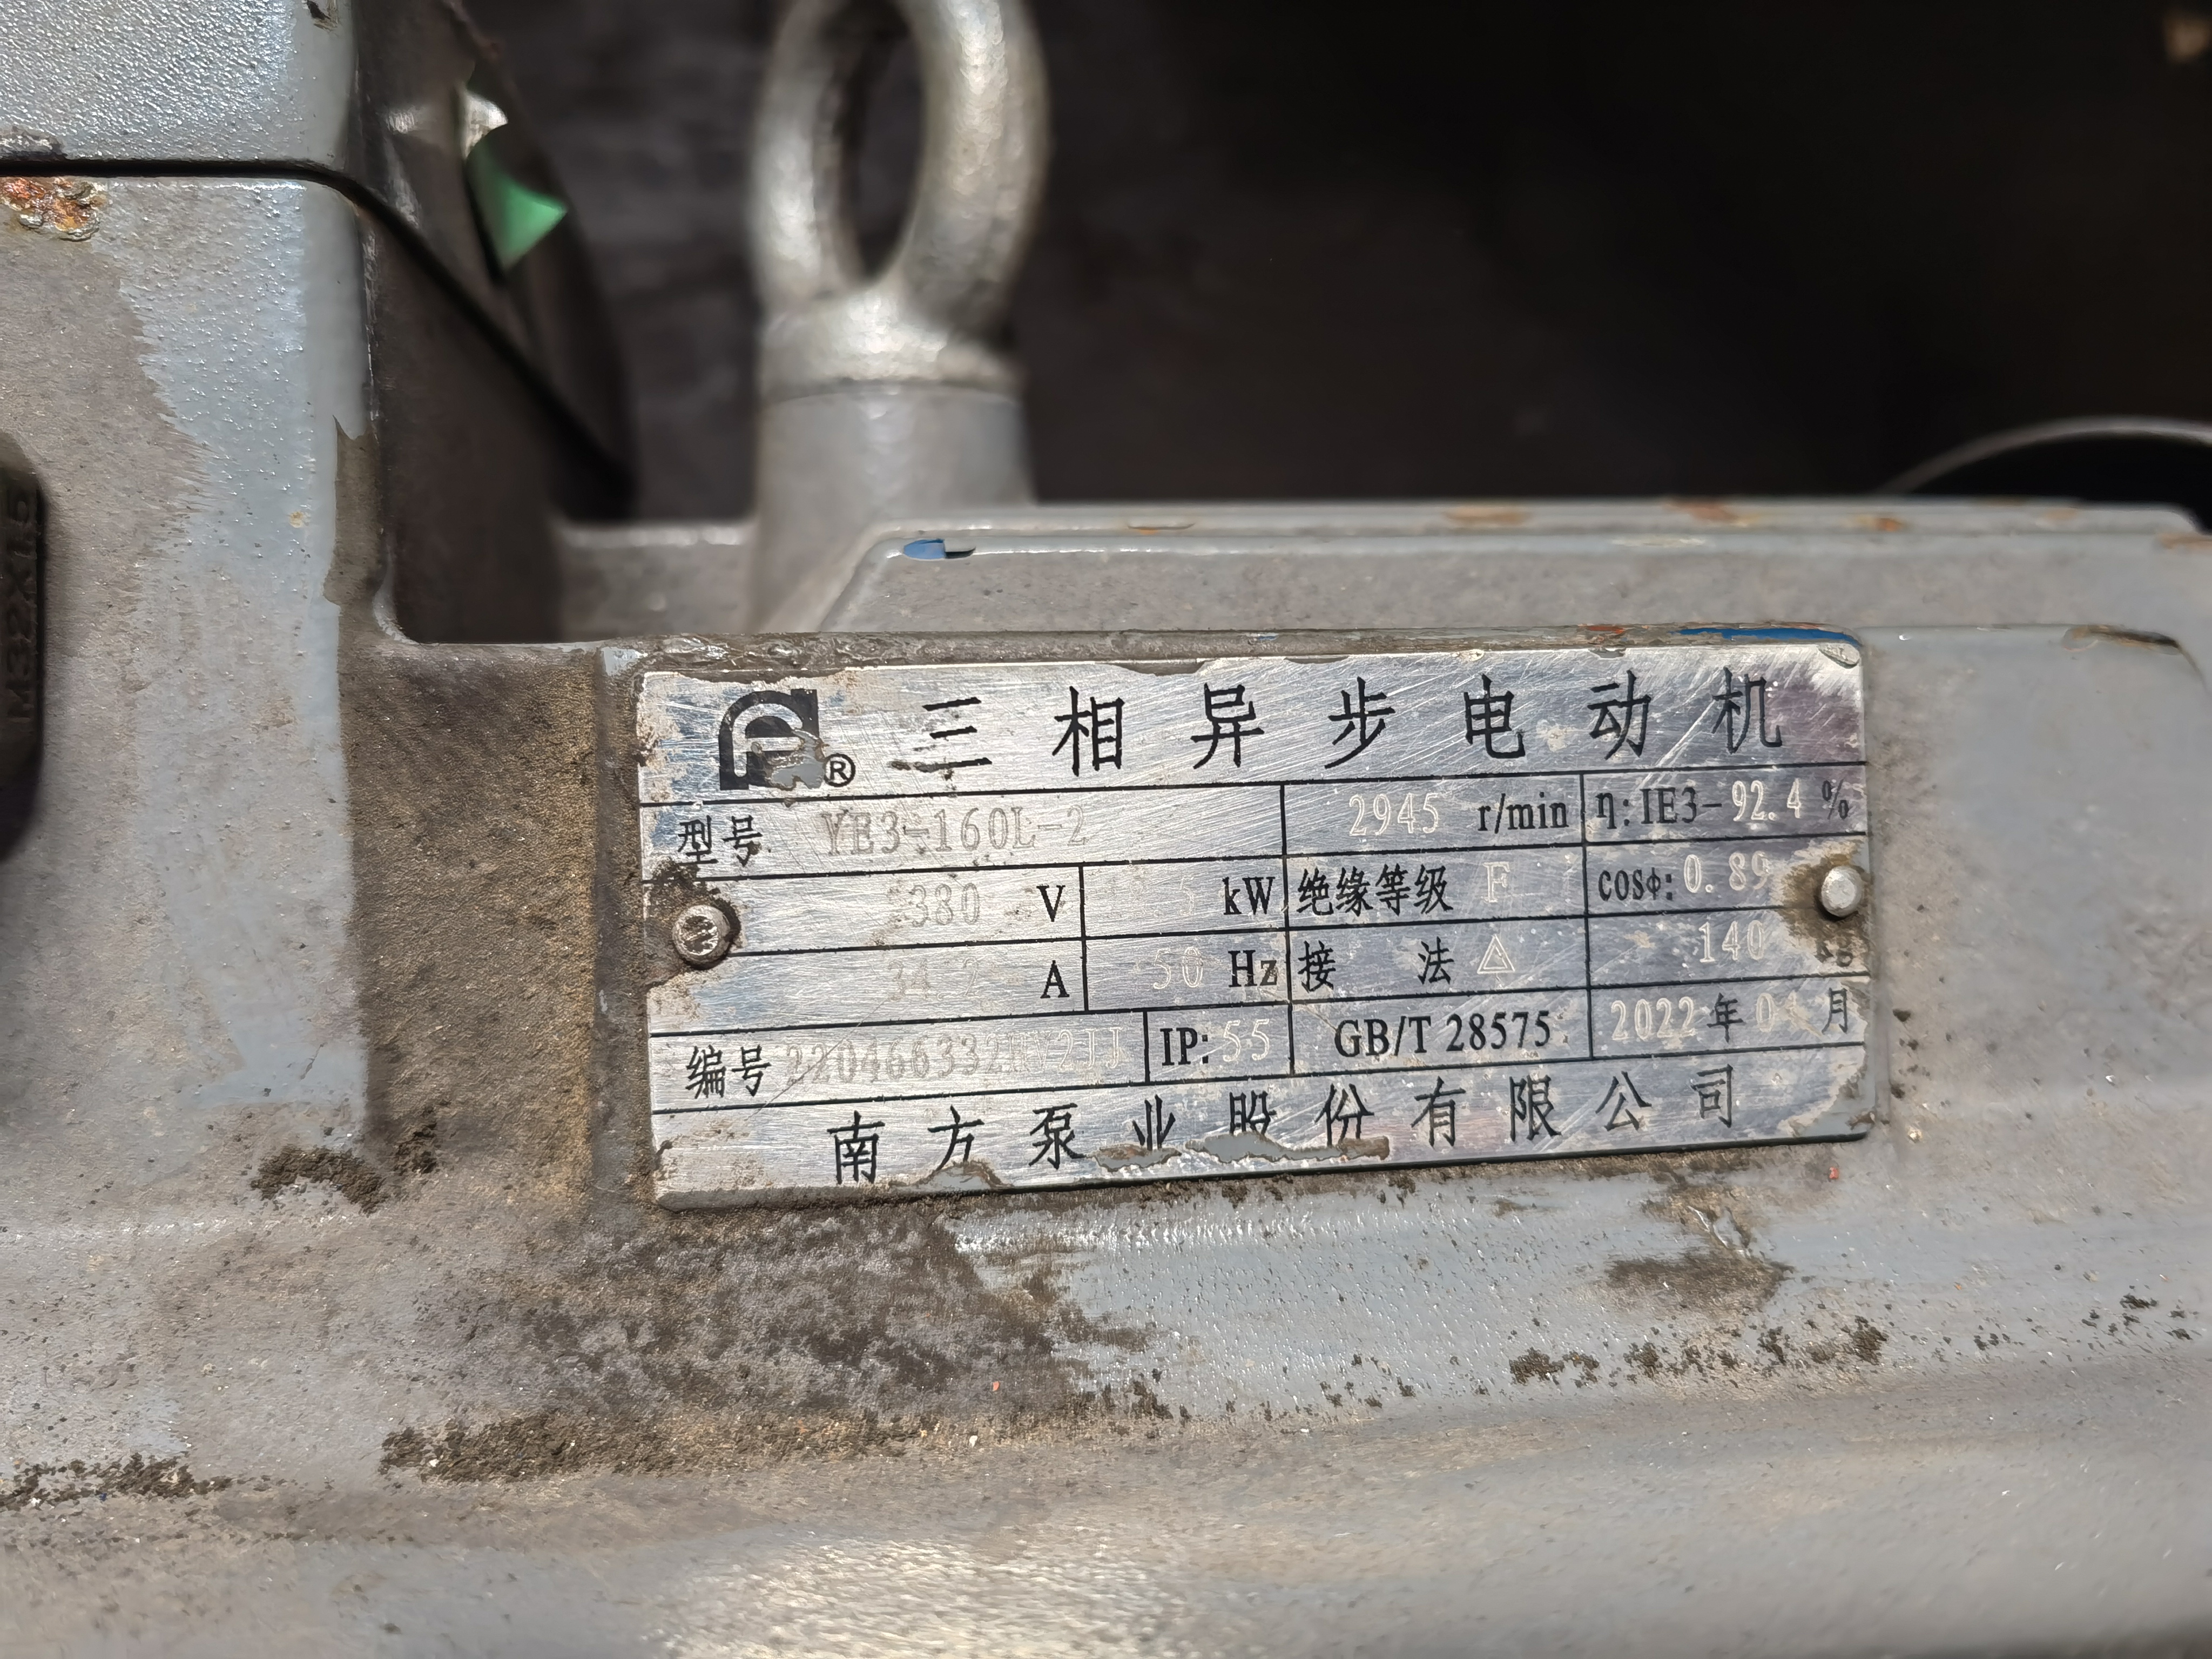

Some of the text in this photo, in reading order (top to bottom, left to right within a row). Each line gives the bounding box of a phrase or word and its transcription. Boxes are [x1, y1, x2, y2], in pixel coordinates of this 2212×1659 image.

[890, 667, 1783, 777] 三相异步电动机
[1349, 790, 1568, 837] 2945 r/min
[677, 815, 763, 867] 型号
[907, 882, 1066, 927] 380 V
[1222, 876, 1276, 915] kW
[1296, 862, 1512, 918] 绝缘等级 F
[1698, 920, 1765, 963] 140
[1041, 961, 1070, 1000] A
[1152, 946, 1279, 990] 50 Hz
[1334, 1009, 1552, 1060] GB/T 28575
[685, 1042, 772, 1101] 编号
[827, 1063, 1734, 1185] 南方泵业股份有限公司
